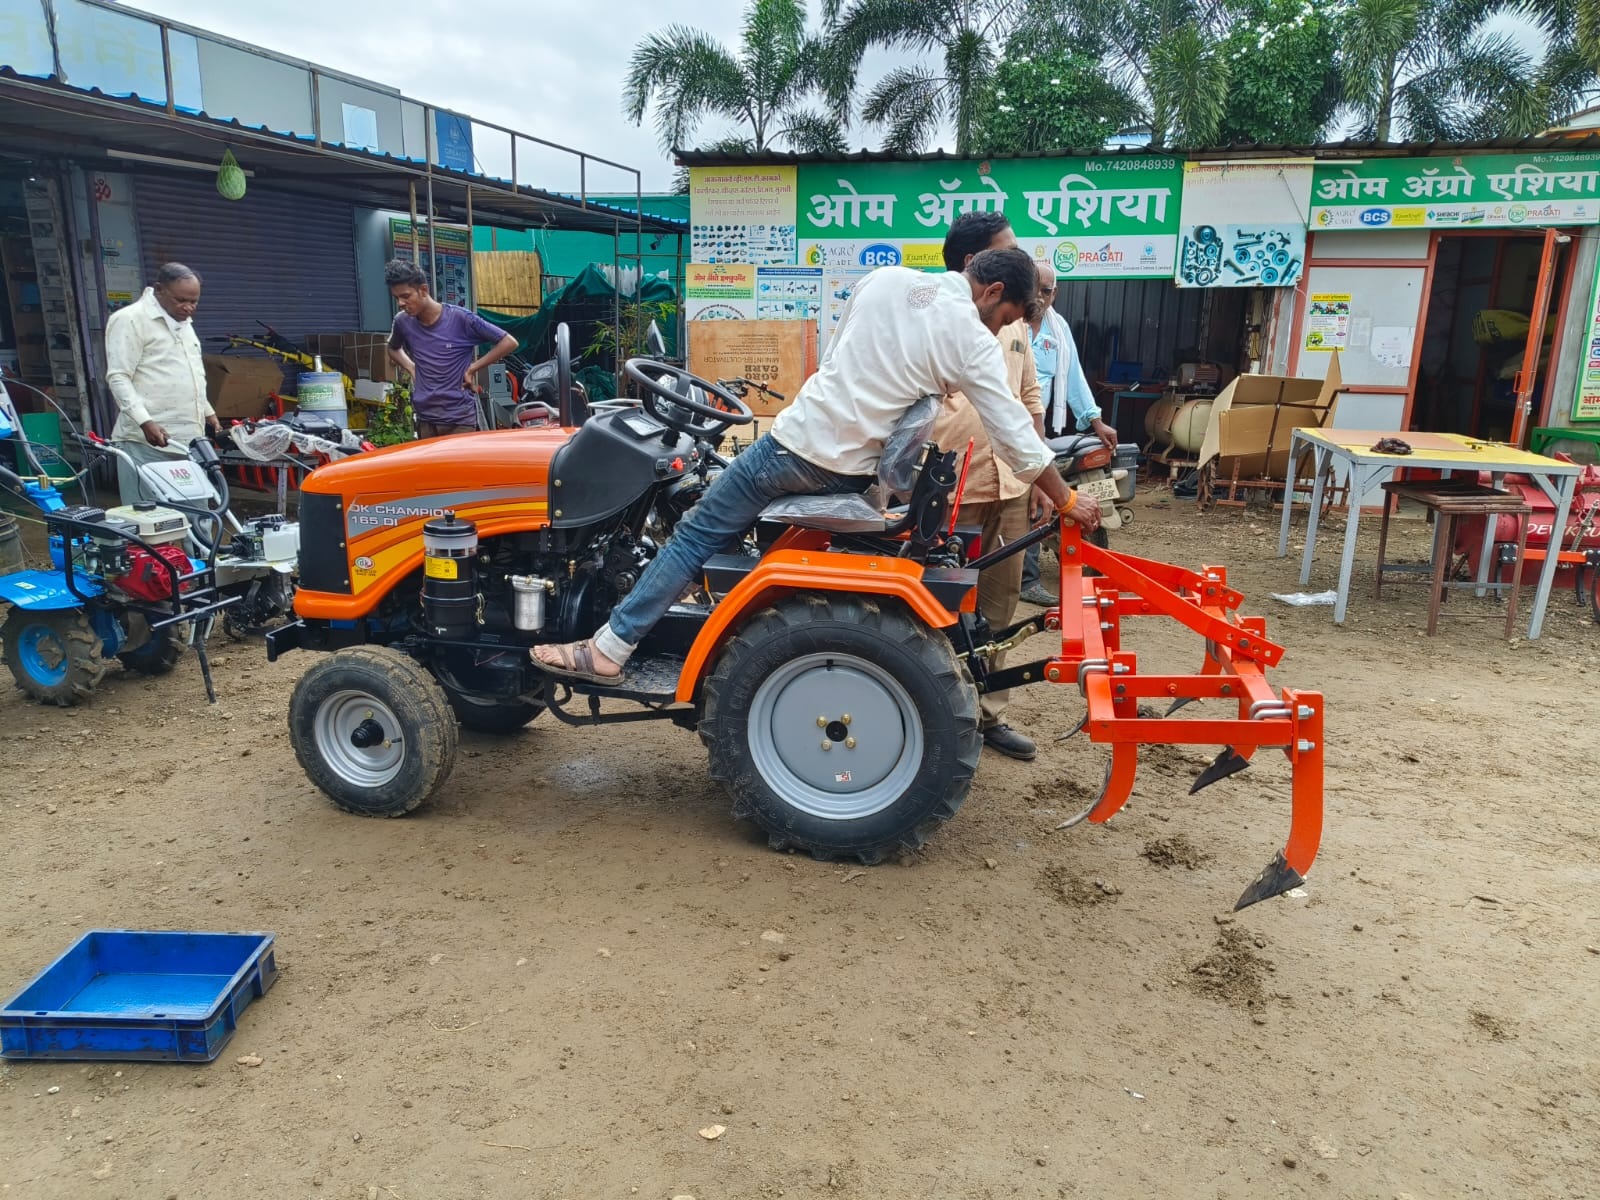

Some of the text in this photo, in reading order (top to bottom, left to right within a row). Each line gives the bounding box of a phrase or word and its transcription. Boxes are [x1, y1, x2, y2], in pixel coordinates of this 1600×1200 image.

[1085, 159, 1175, 172] Mo.7420848939
[1316, 169, 1389, 200] ओम
[1486, 163, 1600, 201] एशिया
[806, 178, 898, 228] ओम
[1022, 173, 1172, 236] एशिया
[1363, 212, 1388, 222] BCS
[1527, 209, 1561, 217] PRAGATI
[829, 246, 854, 257] AGRO
[865, 251, 897, 266] BCS
[1079, 252, 1123, 262] PRAGATI
[744, 365, 779, 373] CARE
[744, 372, 779, 381] AGRO
[349, 503, 370, 513] DK
[351, 516, 398, 526] 165 DI
